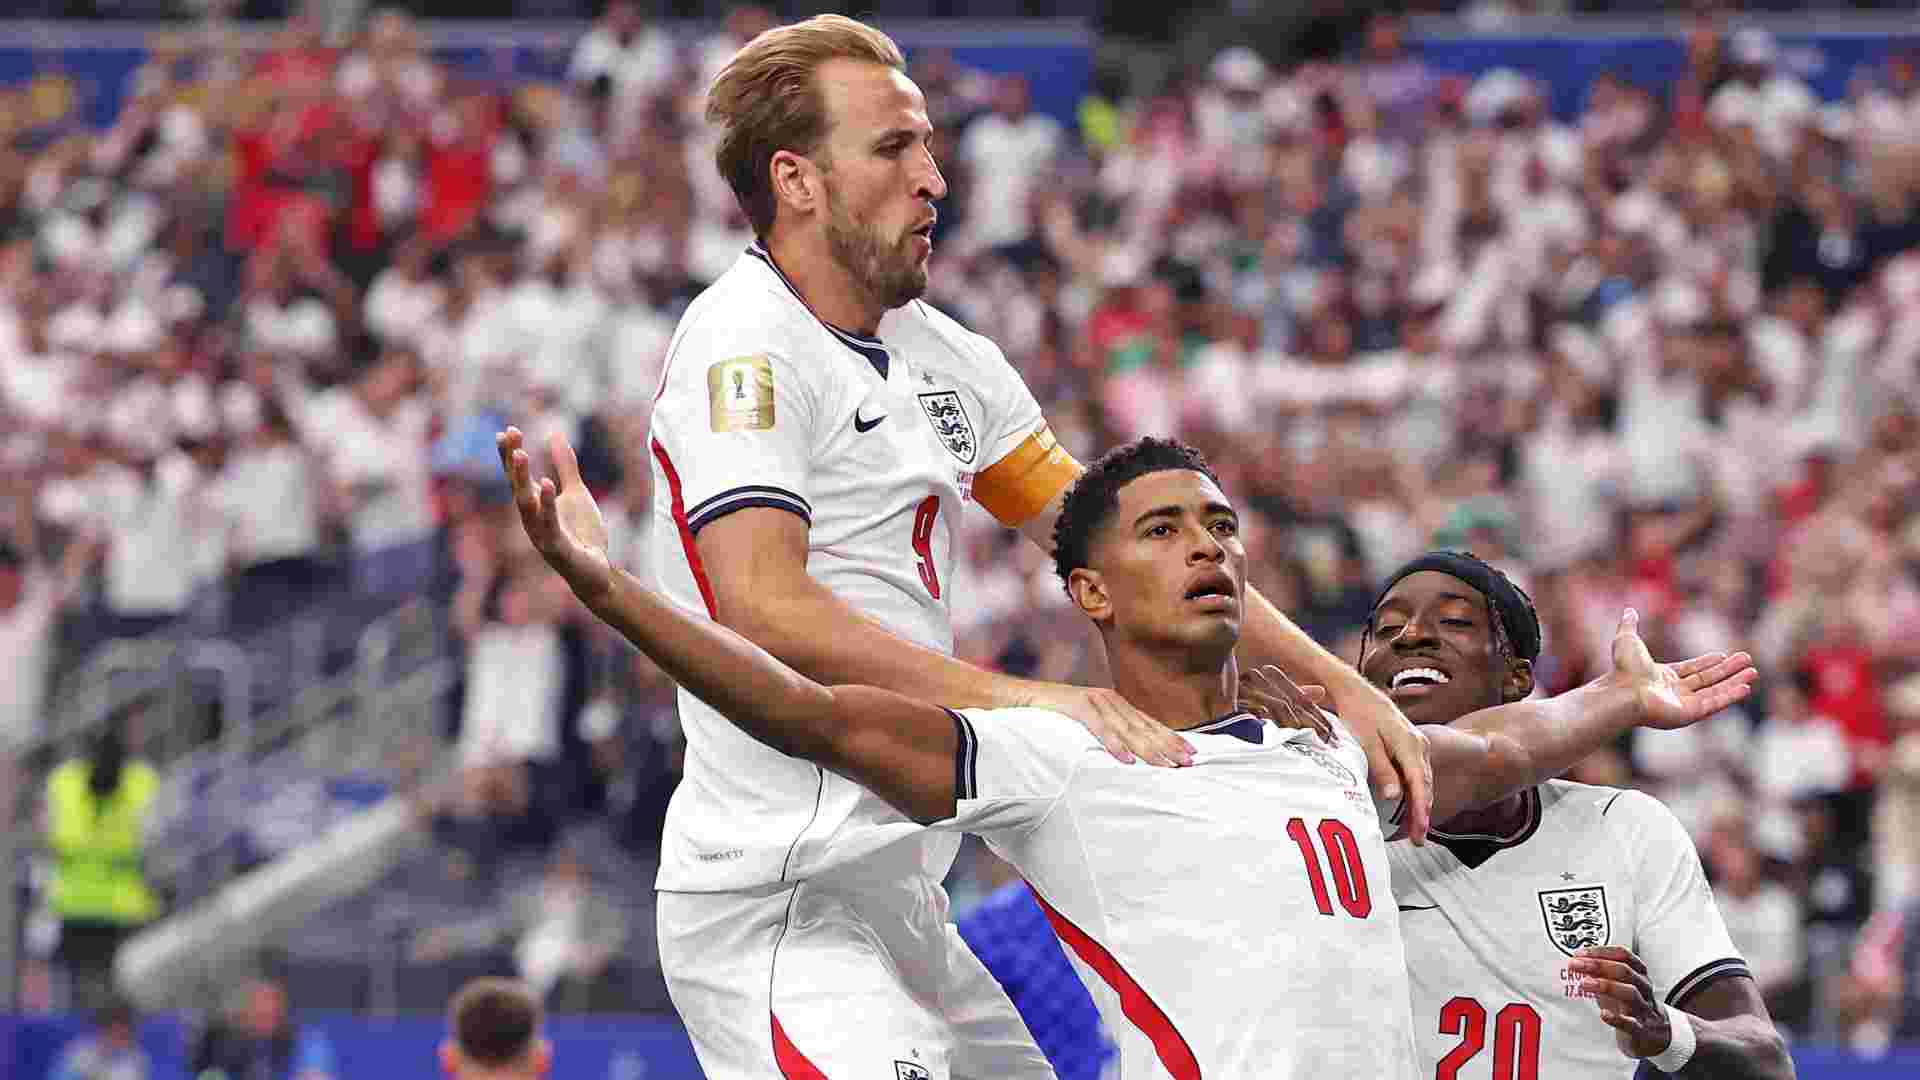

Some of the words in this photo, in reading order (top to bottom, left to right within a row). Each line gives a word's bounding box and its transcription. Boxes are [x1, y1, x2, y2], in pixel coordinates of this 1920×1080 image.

[912, 495, 940, 600] 9
[1286, 817, 1372, 919] 10
[1435, 996, 1542, 1080] 20
